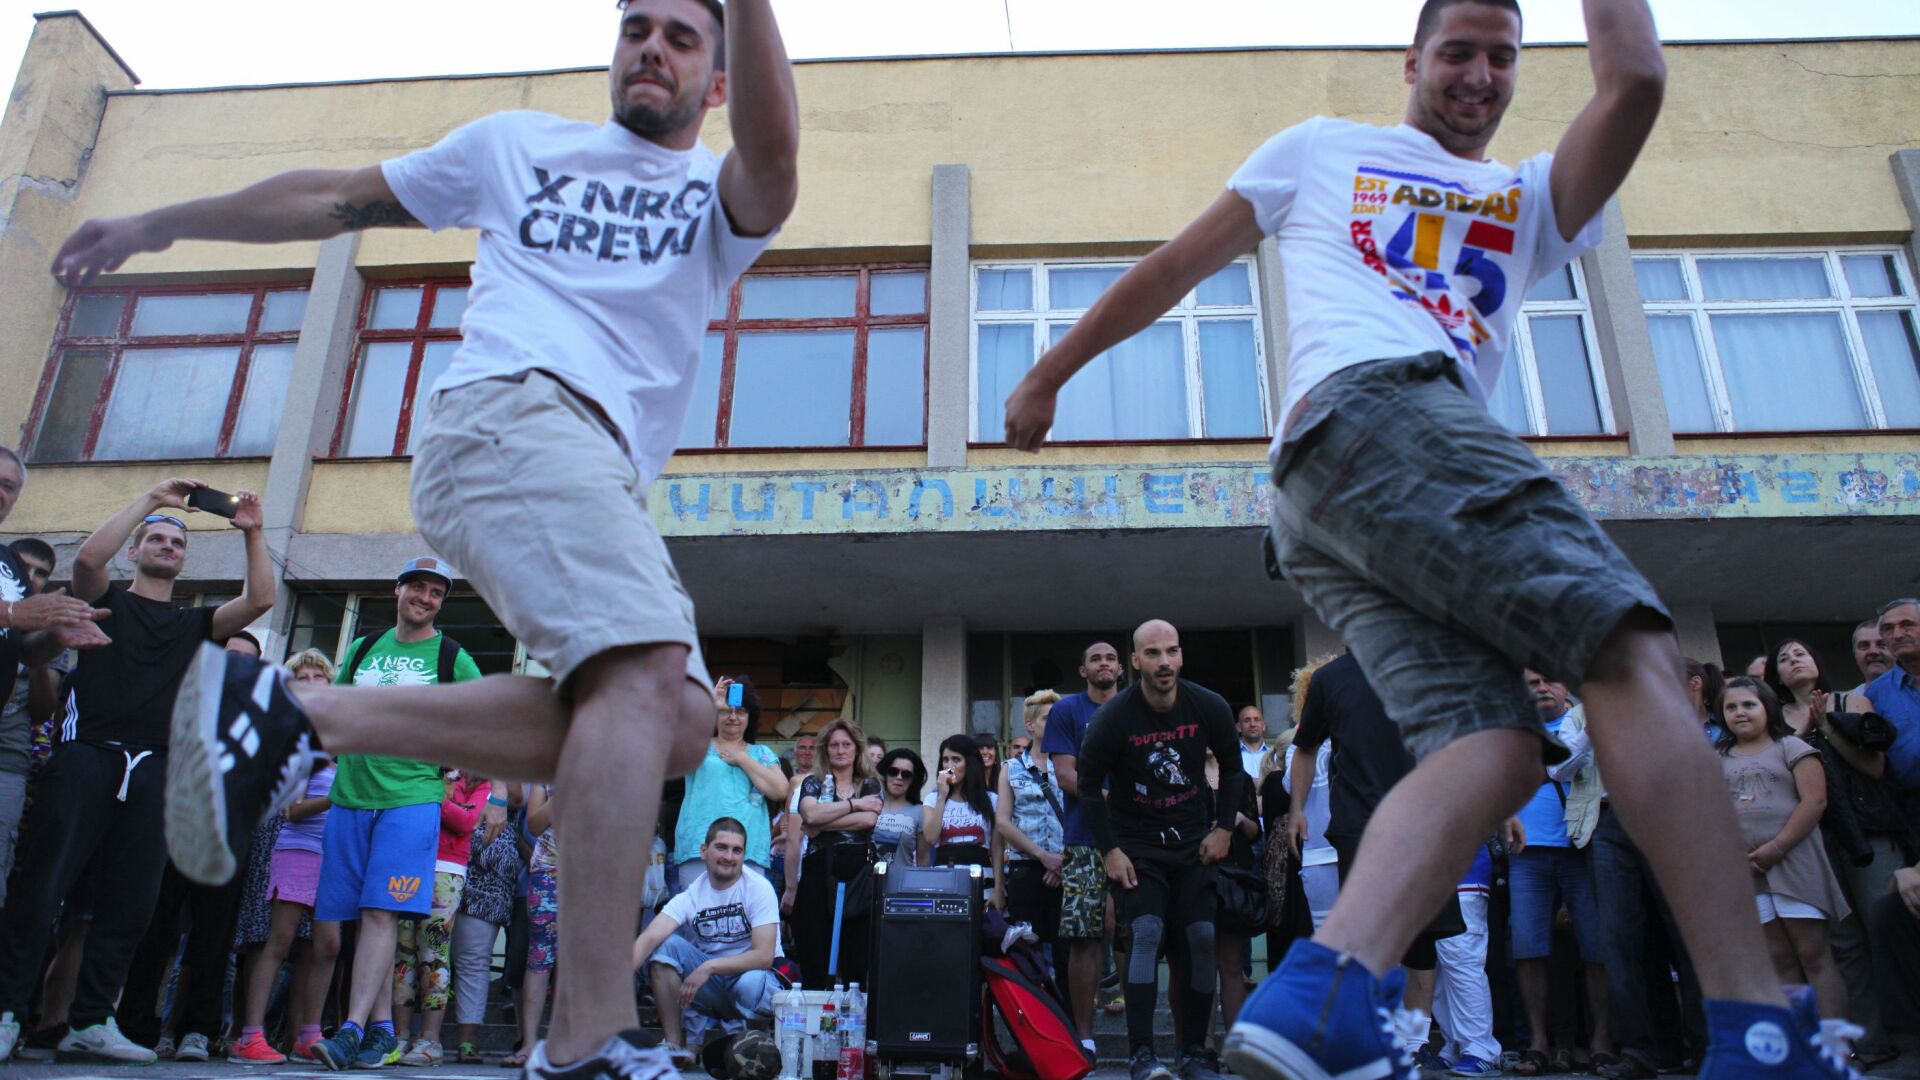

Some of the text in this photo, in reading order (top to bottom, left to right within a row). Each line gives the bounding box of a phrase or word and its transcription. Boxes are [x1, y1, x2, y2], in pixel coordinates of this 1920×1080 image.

[526, 165, 712, 221] X NRG
[1352, 193, 1387, 204] 1969
[1354, 175, 1522, 224] EST ADIDAS
[519, 208, 701, 265] CREW
[1385, 212, 1516, 319] 45
